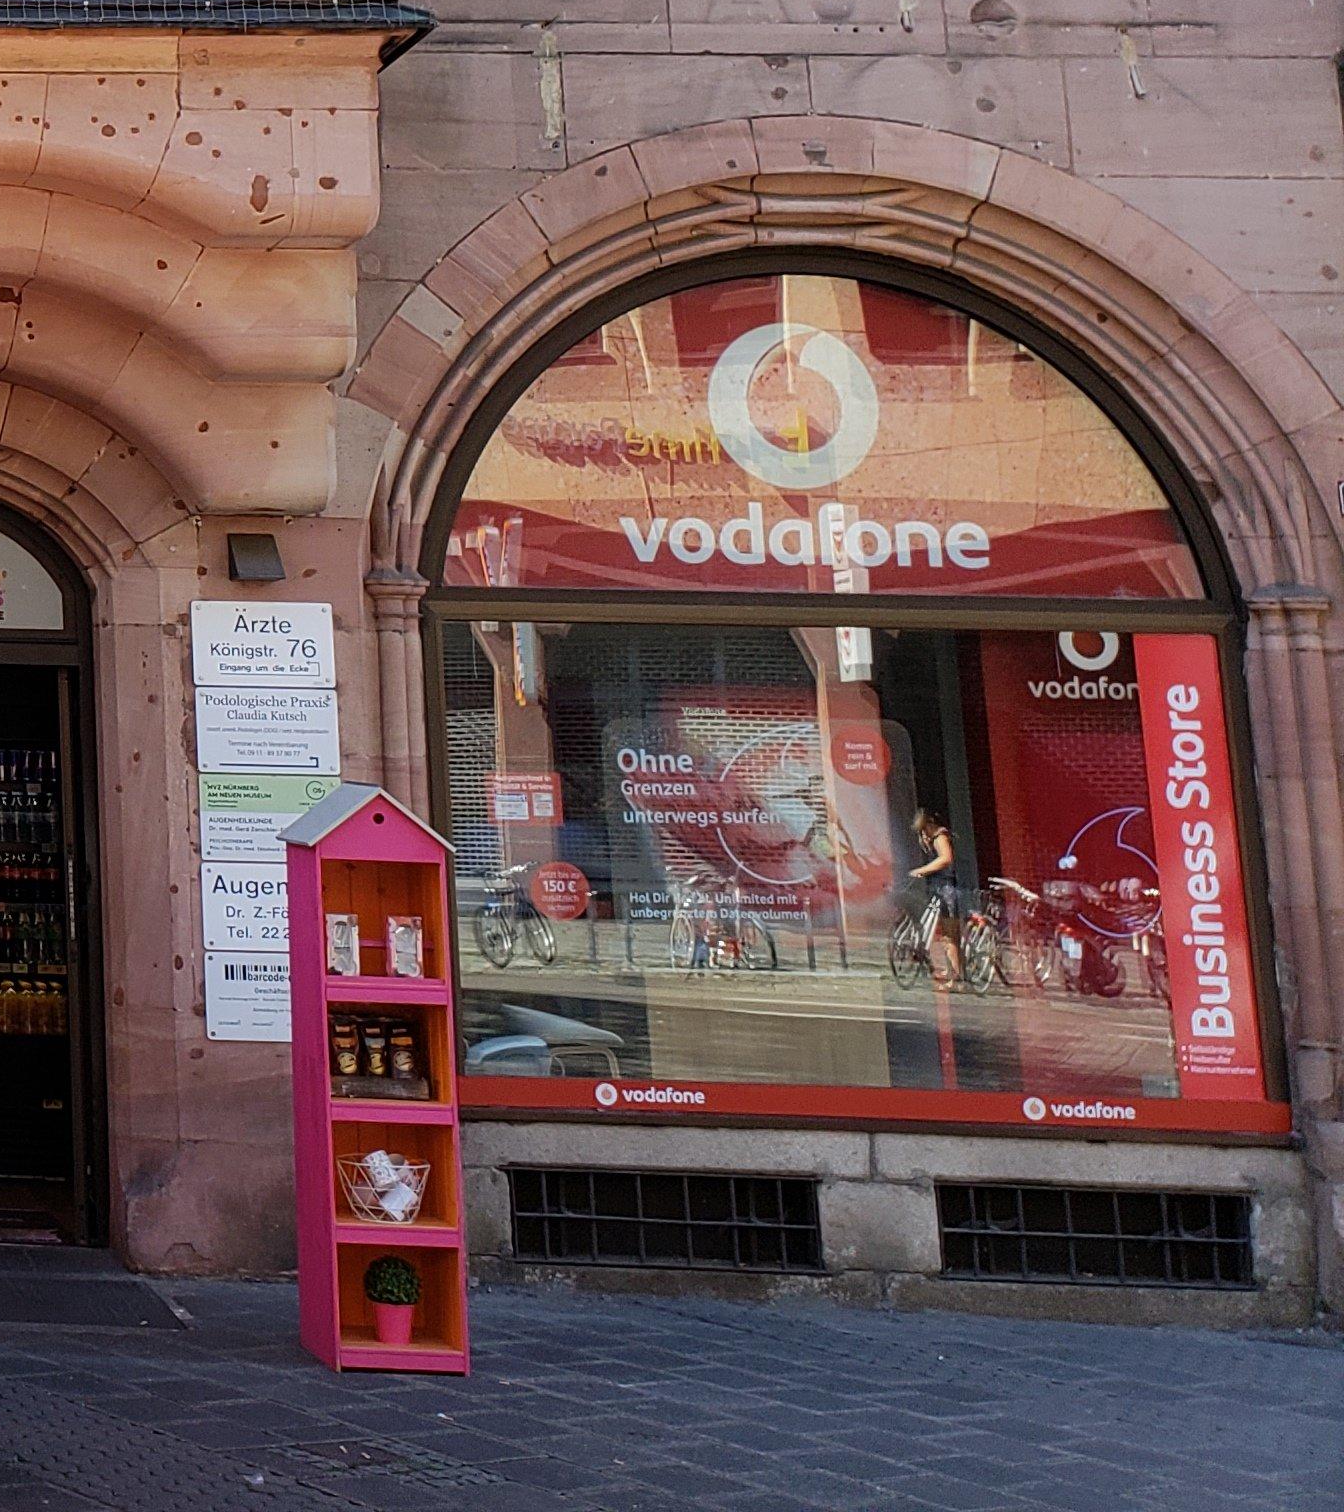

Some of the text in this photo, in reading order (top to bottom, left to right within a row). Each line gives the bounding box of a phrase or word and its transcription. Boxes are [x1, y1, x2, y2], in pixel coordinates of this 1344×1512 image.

[619, 501, 990, 569] vodafone
[234, 608, 292, 634] Ärzte
[210, 638, 317, 659] Königstr. 76
[219, 663, 251, 673] Eingang
[272, 664, 285, 673] die
[289, 665, 309, 673] Ecke
[1028, 675, 1139, 702] vodafon
[204, 694, 329, 708] Podologische Praxis
[227, 710, 307, 722] Claudia Kutsch
[617, 748, 694, 773] Ohne
[620, 780, 696, 796] Grenzen
[623, 808, 782, 826] unterwegs surfen
[1166, 683, 1236, 1038] Business Store
[543, 880, 576, 892] 150 €
[629, 892, 650, 903] Hol
[653, 892, 669, 903] Dir
[777, 892, 798, 904] mit
[226, 905, 245, 918] Dr.
[227, 926, 252, 938] Tel.
[622, 1087, 706, 1104] vodafone
[1050, 1101, 1136, 1120] vodafone
